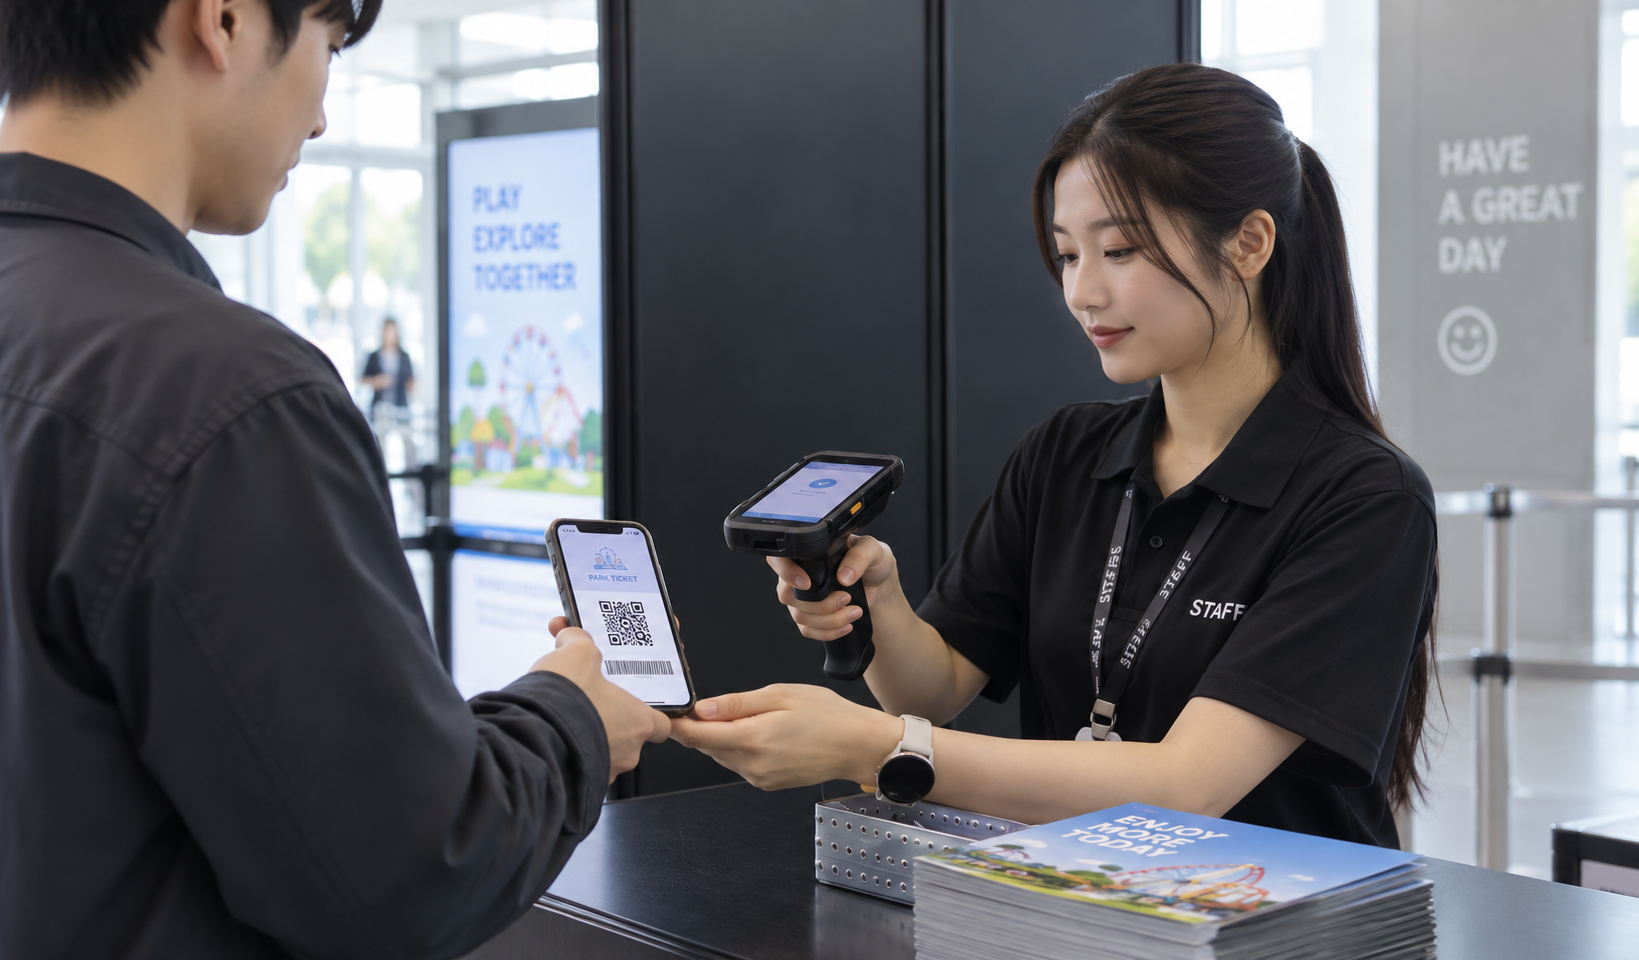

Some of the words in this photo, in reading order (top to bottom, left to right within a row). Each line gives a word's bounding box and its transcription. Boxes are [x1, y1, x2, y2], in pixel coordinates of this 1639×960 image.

[1438, 135, 1530, 176] HAVE
[473, 183, 522, 213] PLAY
[1437, 188, 1466, 225] A
[1471, 182, 1584, 224] GREAT
[474, 222, 560, 253] EXPLORE
[1438, 235, 1508, 273] DAY
[473, 261, 577, 292] TOGETHER
[588, 574, 609, 582] PARK
[611, 575, 638, 583] TICKET
[1189, 599, 1245, 621] STAFF
[1087, 822, 1196, 848] MORE
[1114, 815, 1230, 840] ENJOY
[1061, 829, 1179, 857] TODAY
